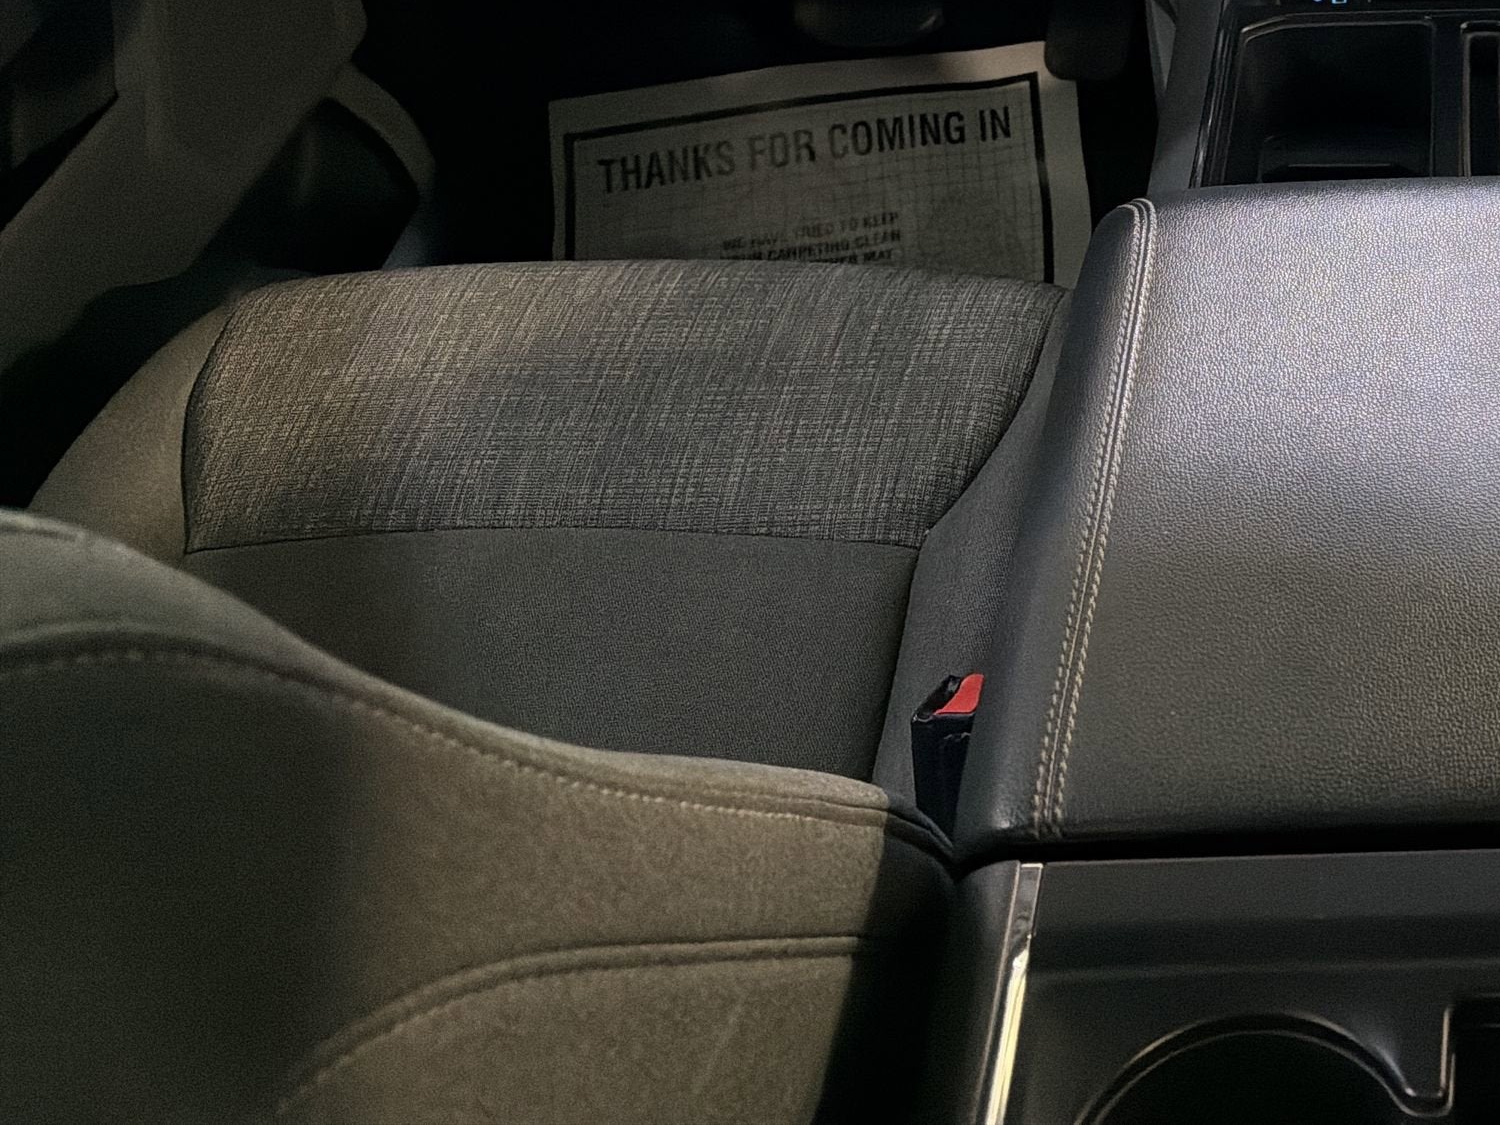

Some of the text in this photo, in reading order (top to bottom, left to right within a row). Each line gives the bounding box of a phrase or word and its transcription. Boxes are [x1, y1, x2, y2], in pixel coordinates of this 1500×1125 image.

[596, 105, 1013, 194] THANKS FOR COMING IN
